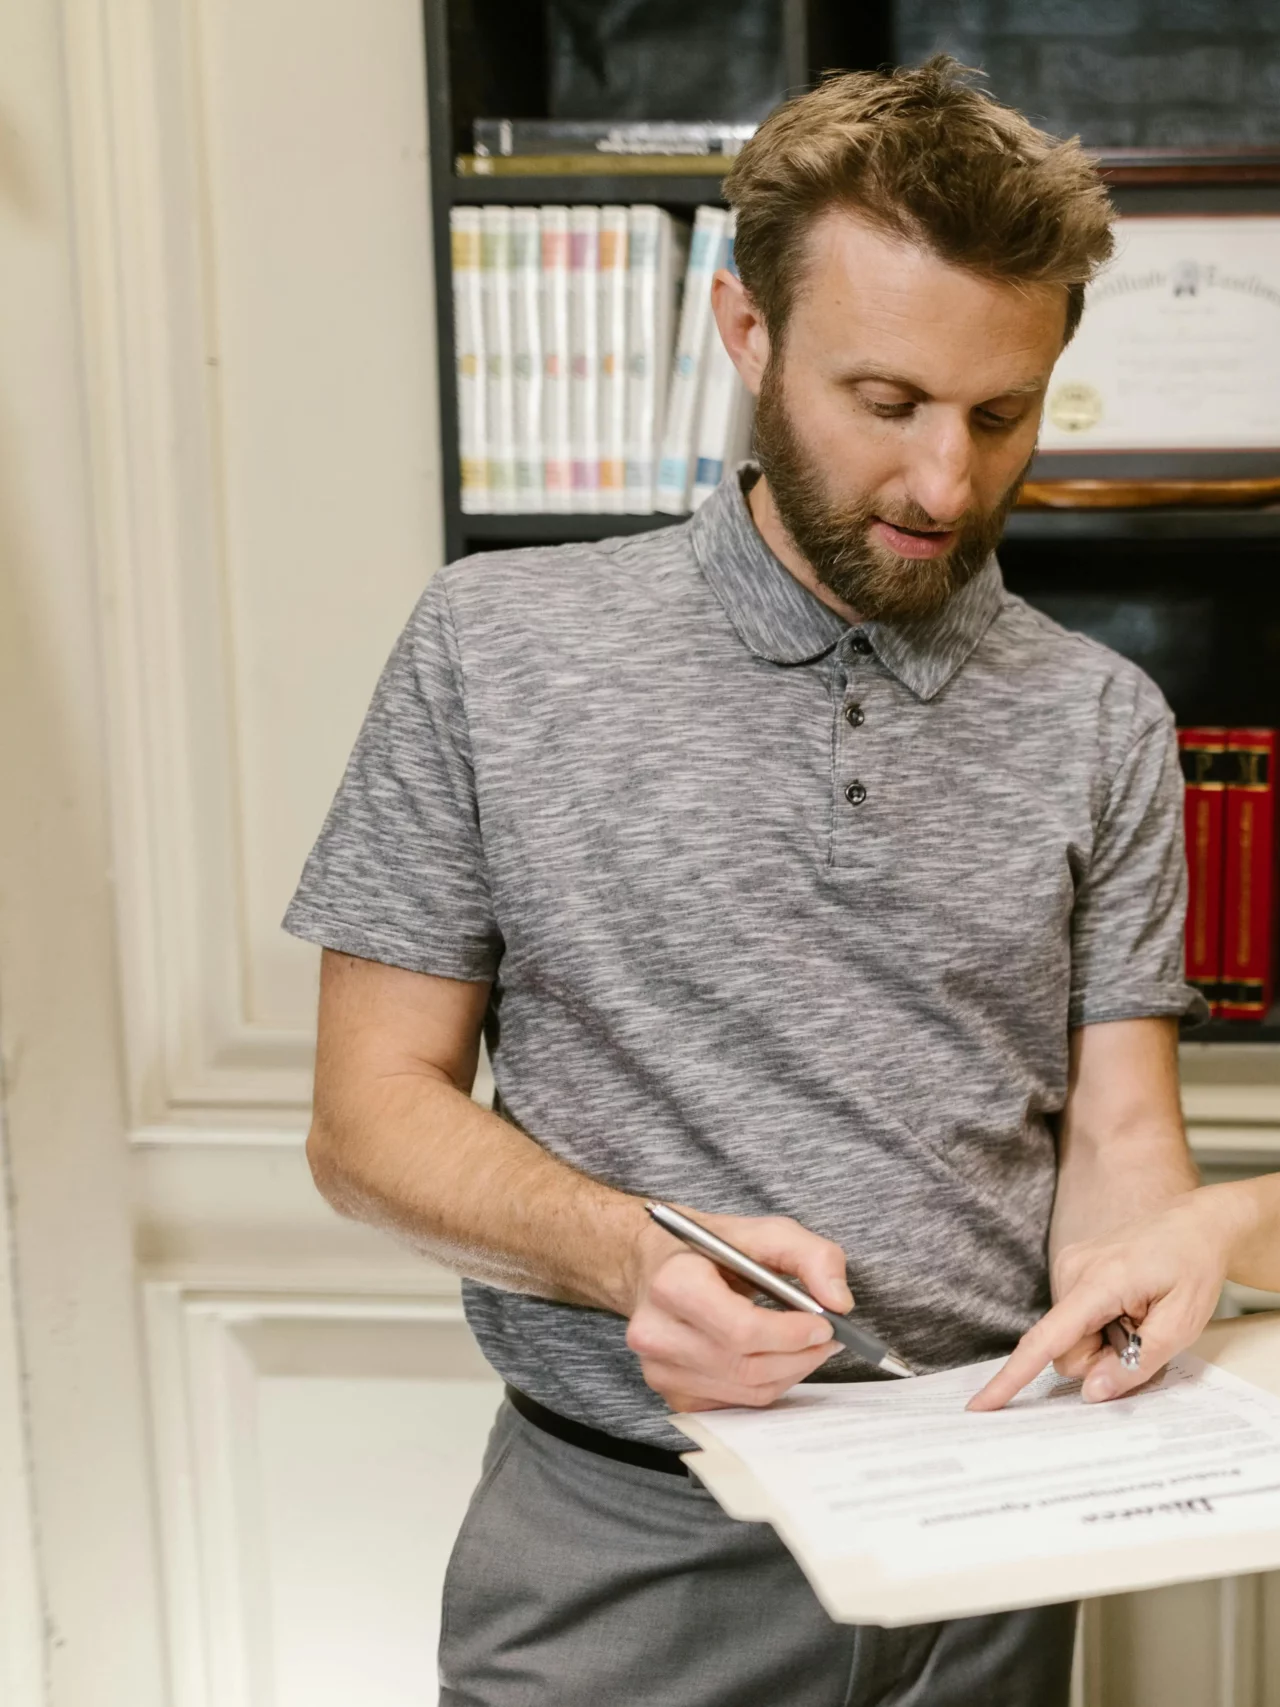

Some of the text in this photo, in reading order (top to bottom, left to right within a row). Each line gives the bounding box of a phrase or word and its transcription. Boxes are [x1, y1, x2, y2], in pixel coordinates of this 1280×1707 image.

[1168, 1468, 1242, 1487] Product
[1037, 1480, 1166, 1508] Development
[918, 1500, 1032, 1528] Agreement
